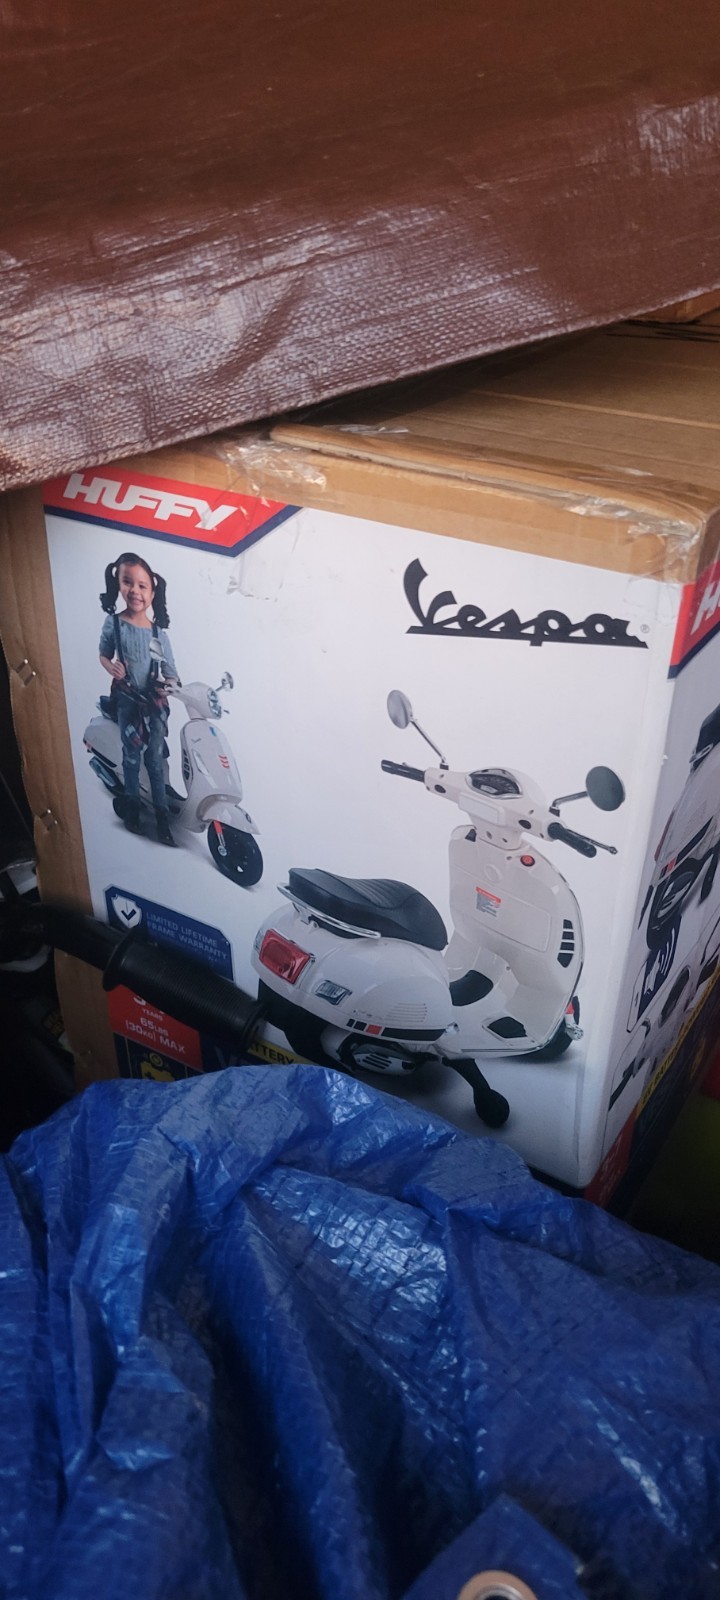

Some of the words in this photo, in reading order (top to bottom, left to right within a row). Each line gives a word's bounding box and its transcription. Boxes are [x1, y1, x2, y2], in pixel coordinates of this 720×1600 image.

[63, 473, 238, 531] HUFFY
[403, 558, 649, 649] Vespa
[146, 911, 179, 931] LIMITED
[181, 926, 218, 948] LIFETIME
[147, 920, 176, 938] FRAME
[178, 934, 227, 960] WARRANTY
[142, 1008, 164, 1021] YEARS
[159, 1035, 186, 1054] MAX
